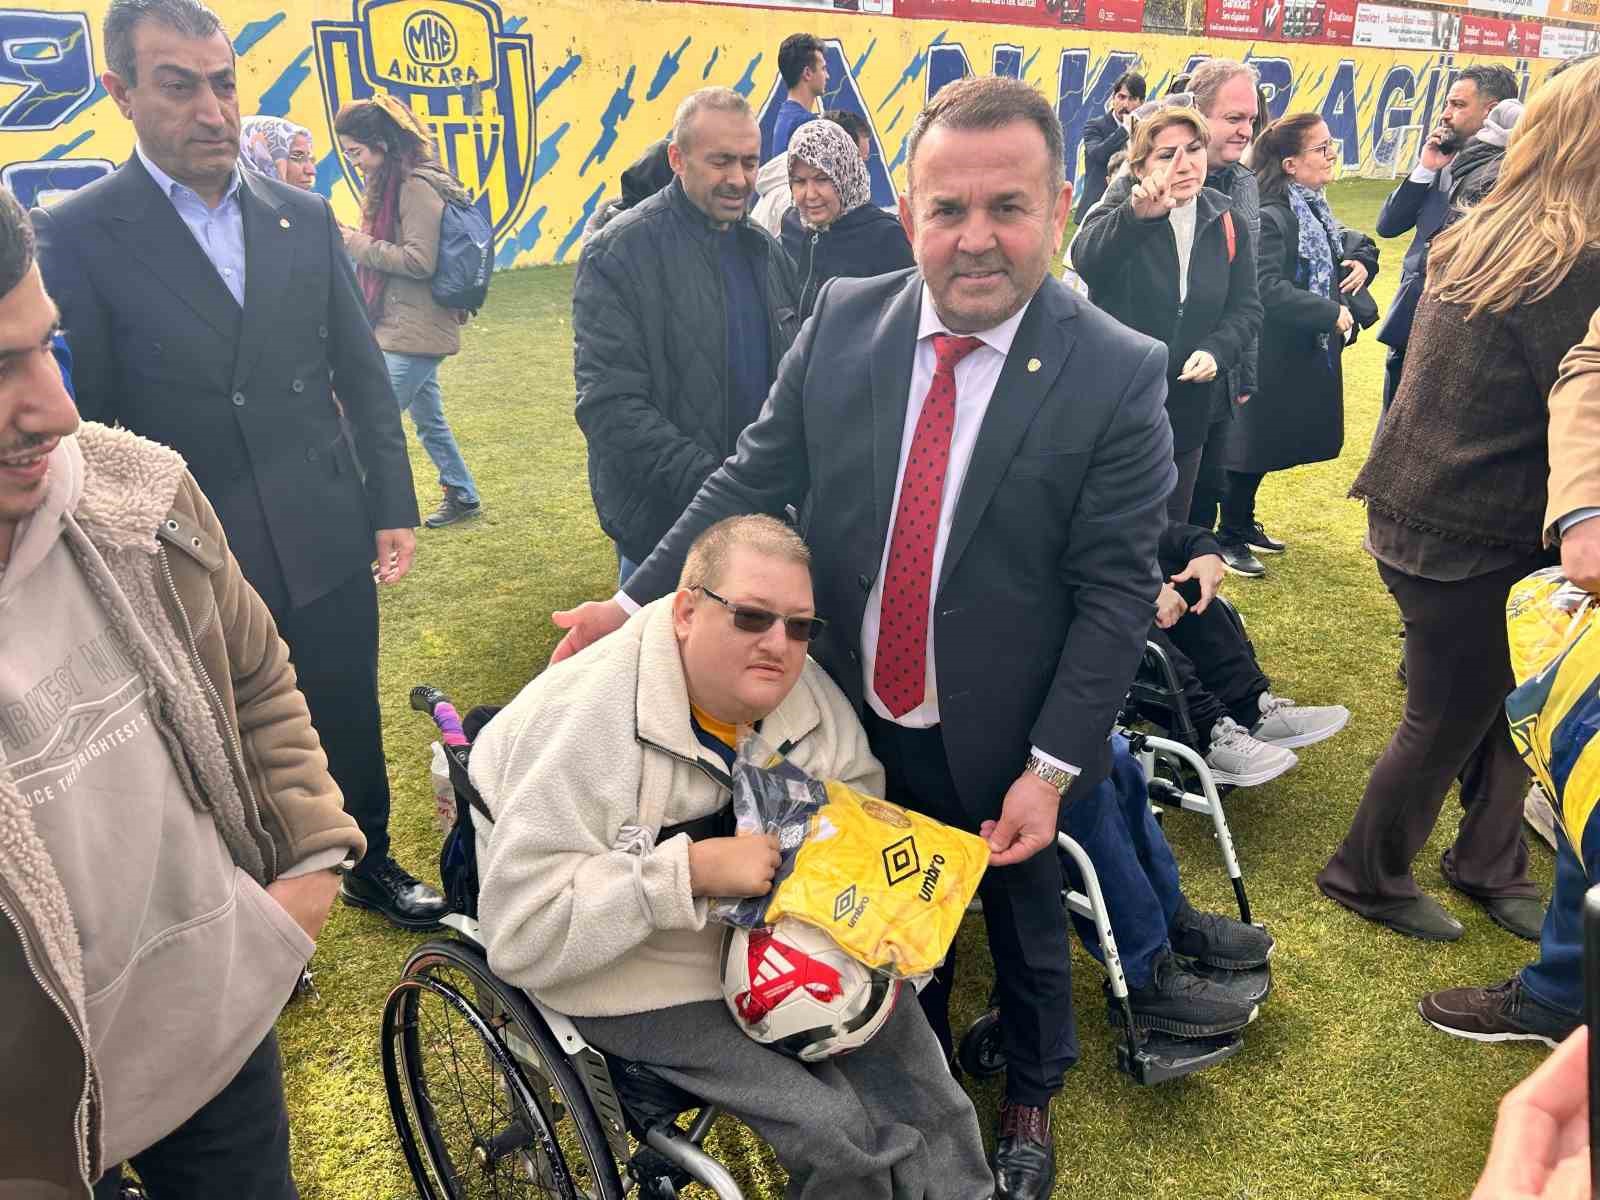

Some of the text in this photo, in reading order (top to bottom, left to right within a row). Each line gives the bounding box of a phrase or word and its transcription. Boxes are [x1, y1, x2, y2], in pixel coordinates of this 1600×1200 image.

[406, 17, 452, 61] MKE
[387, 58, 480, 84] ANKARA
[918, 854, 945, 902] umbro
[847, 896, 869, 928] umbro
